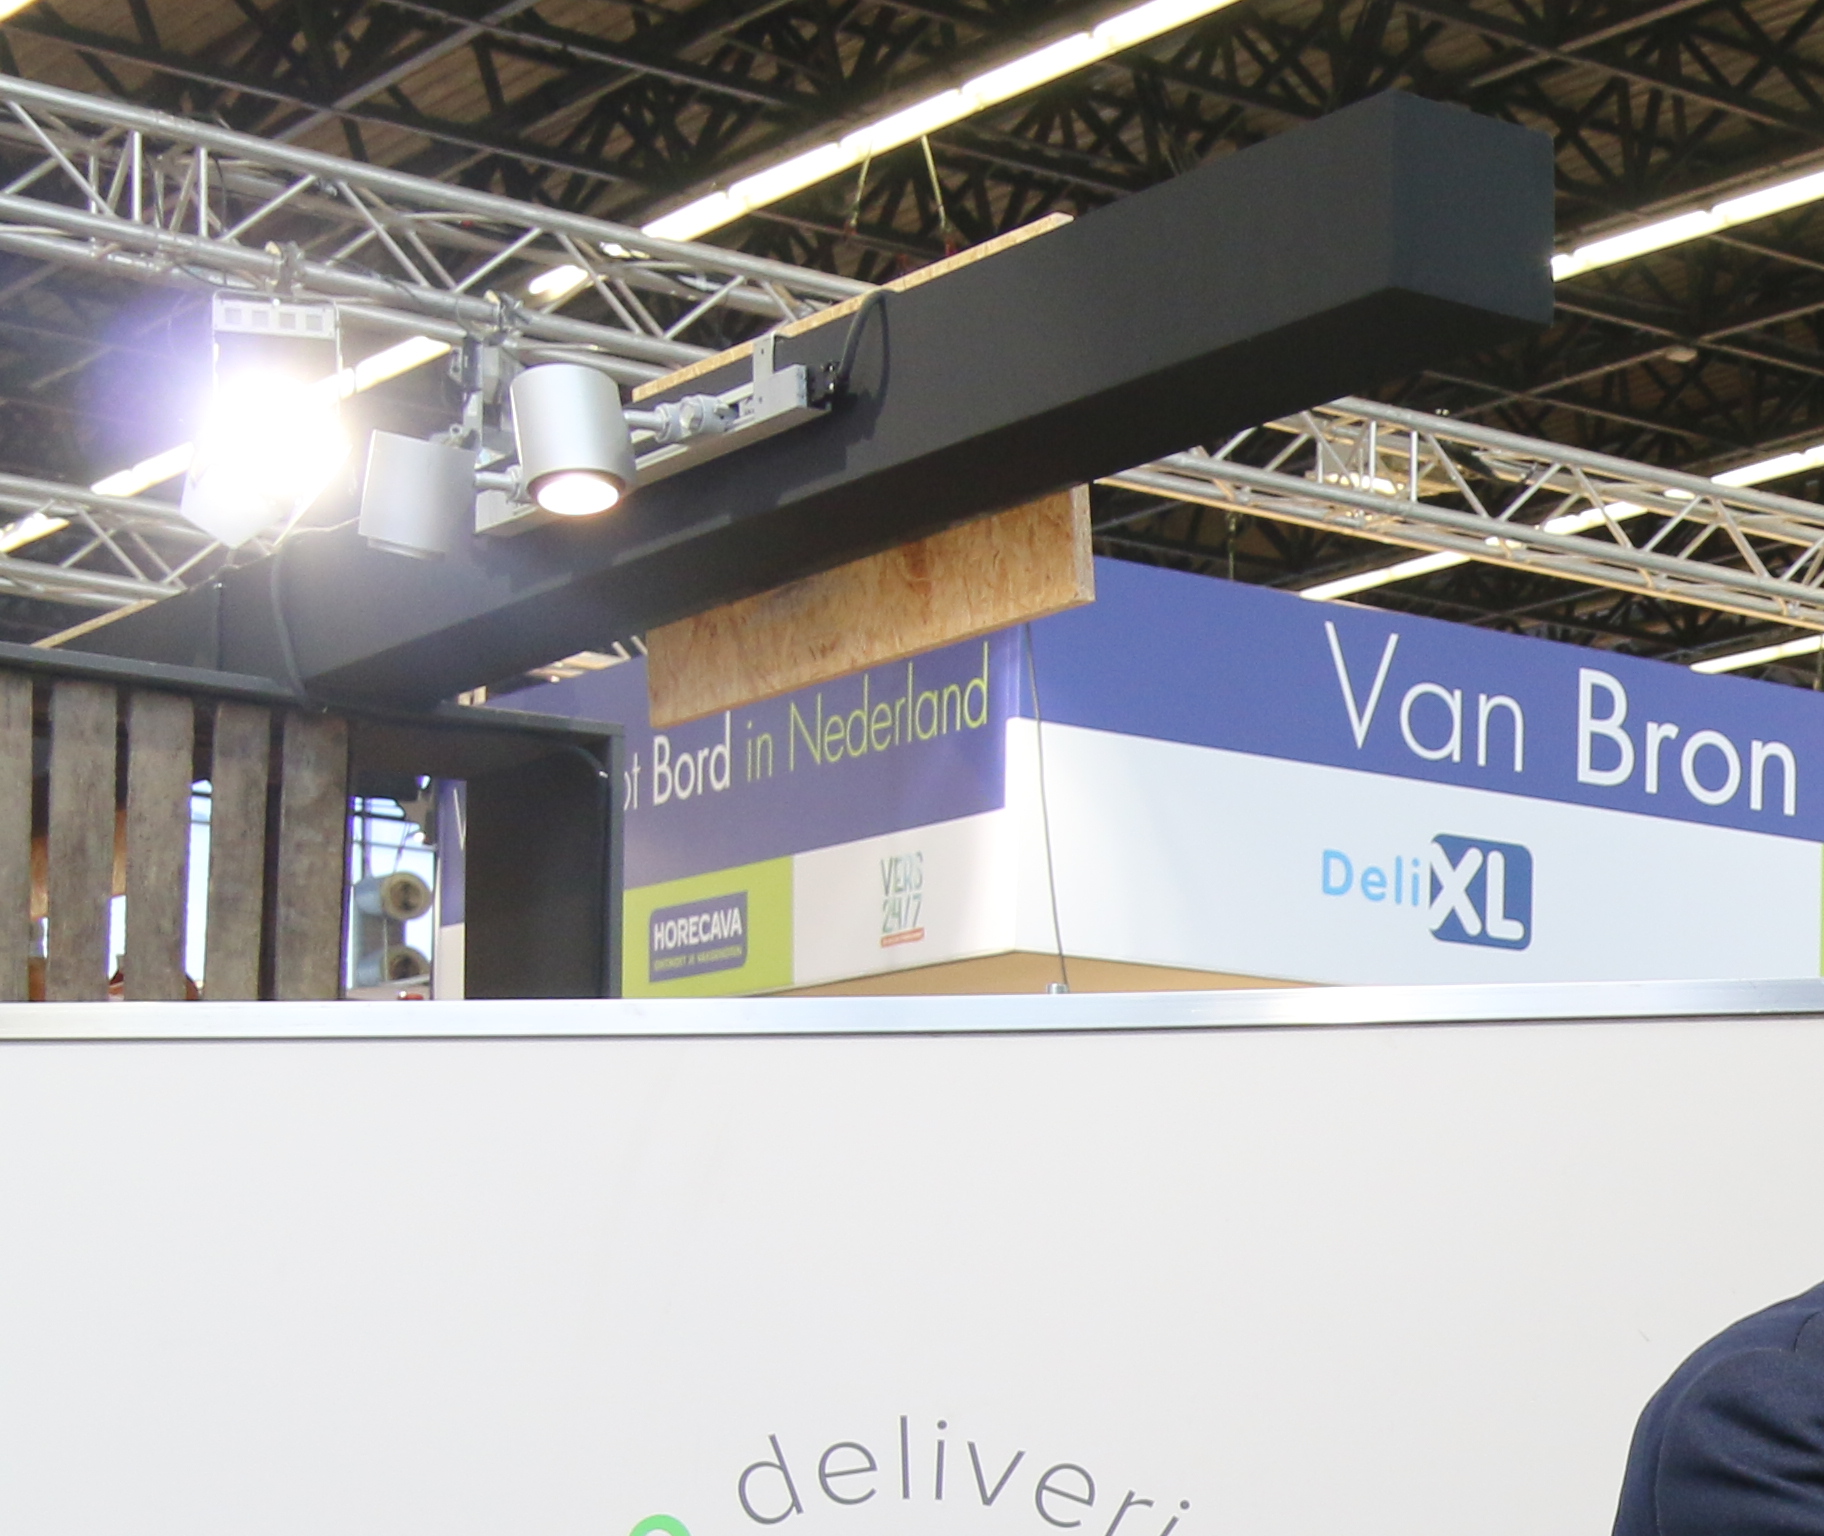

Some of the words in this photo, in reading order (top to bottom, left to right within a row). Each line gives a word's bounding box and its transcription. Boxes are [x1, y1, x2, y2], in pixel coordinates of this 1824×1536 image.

[653, 710, 732, 806] Bord
[746, 720, 773, 783] in
[790, 641, 988, 772] Nederland
[1324, 620, 1525, 774] Van
[1577, 667, 1797, 817] Bron
[880, 850, 924, 897] VERS
[1321, 837, 1526, 941] DeliXL
[654, 907, 743, 952] HORECAVA
[881, 893, 922, 934] 24/7
